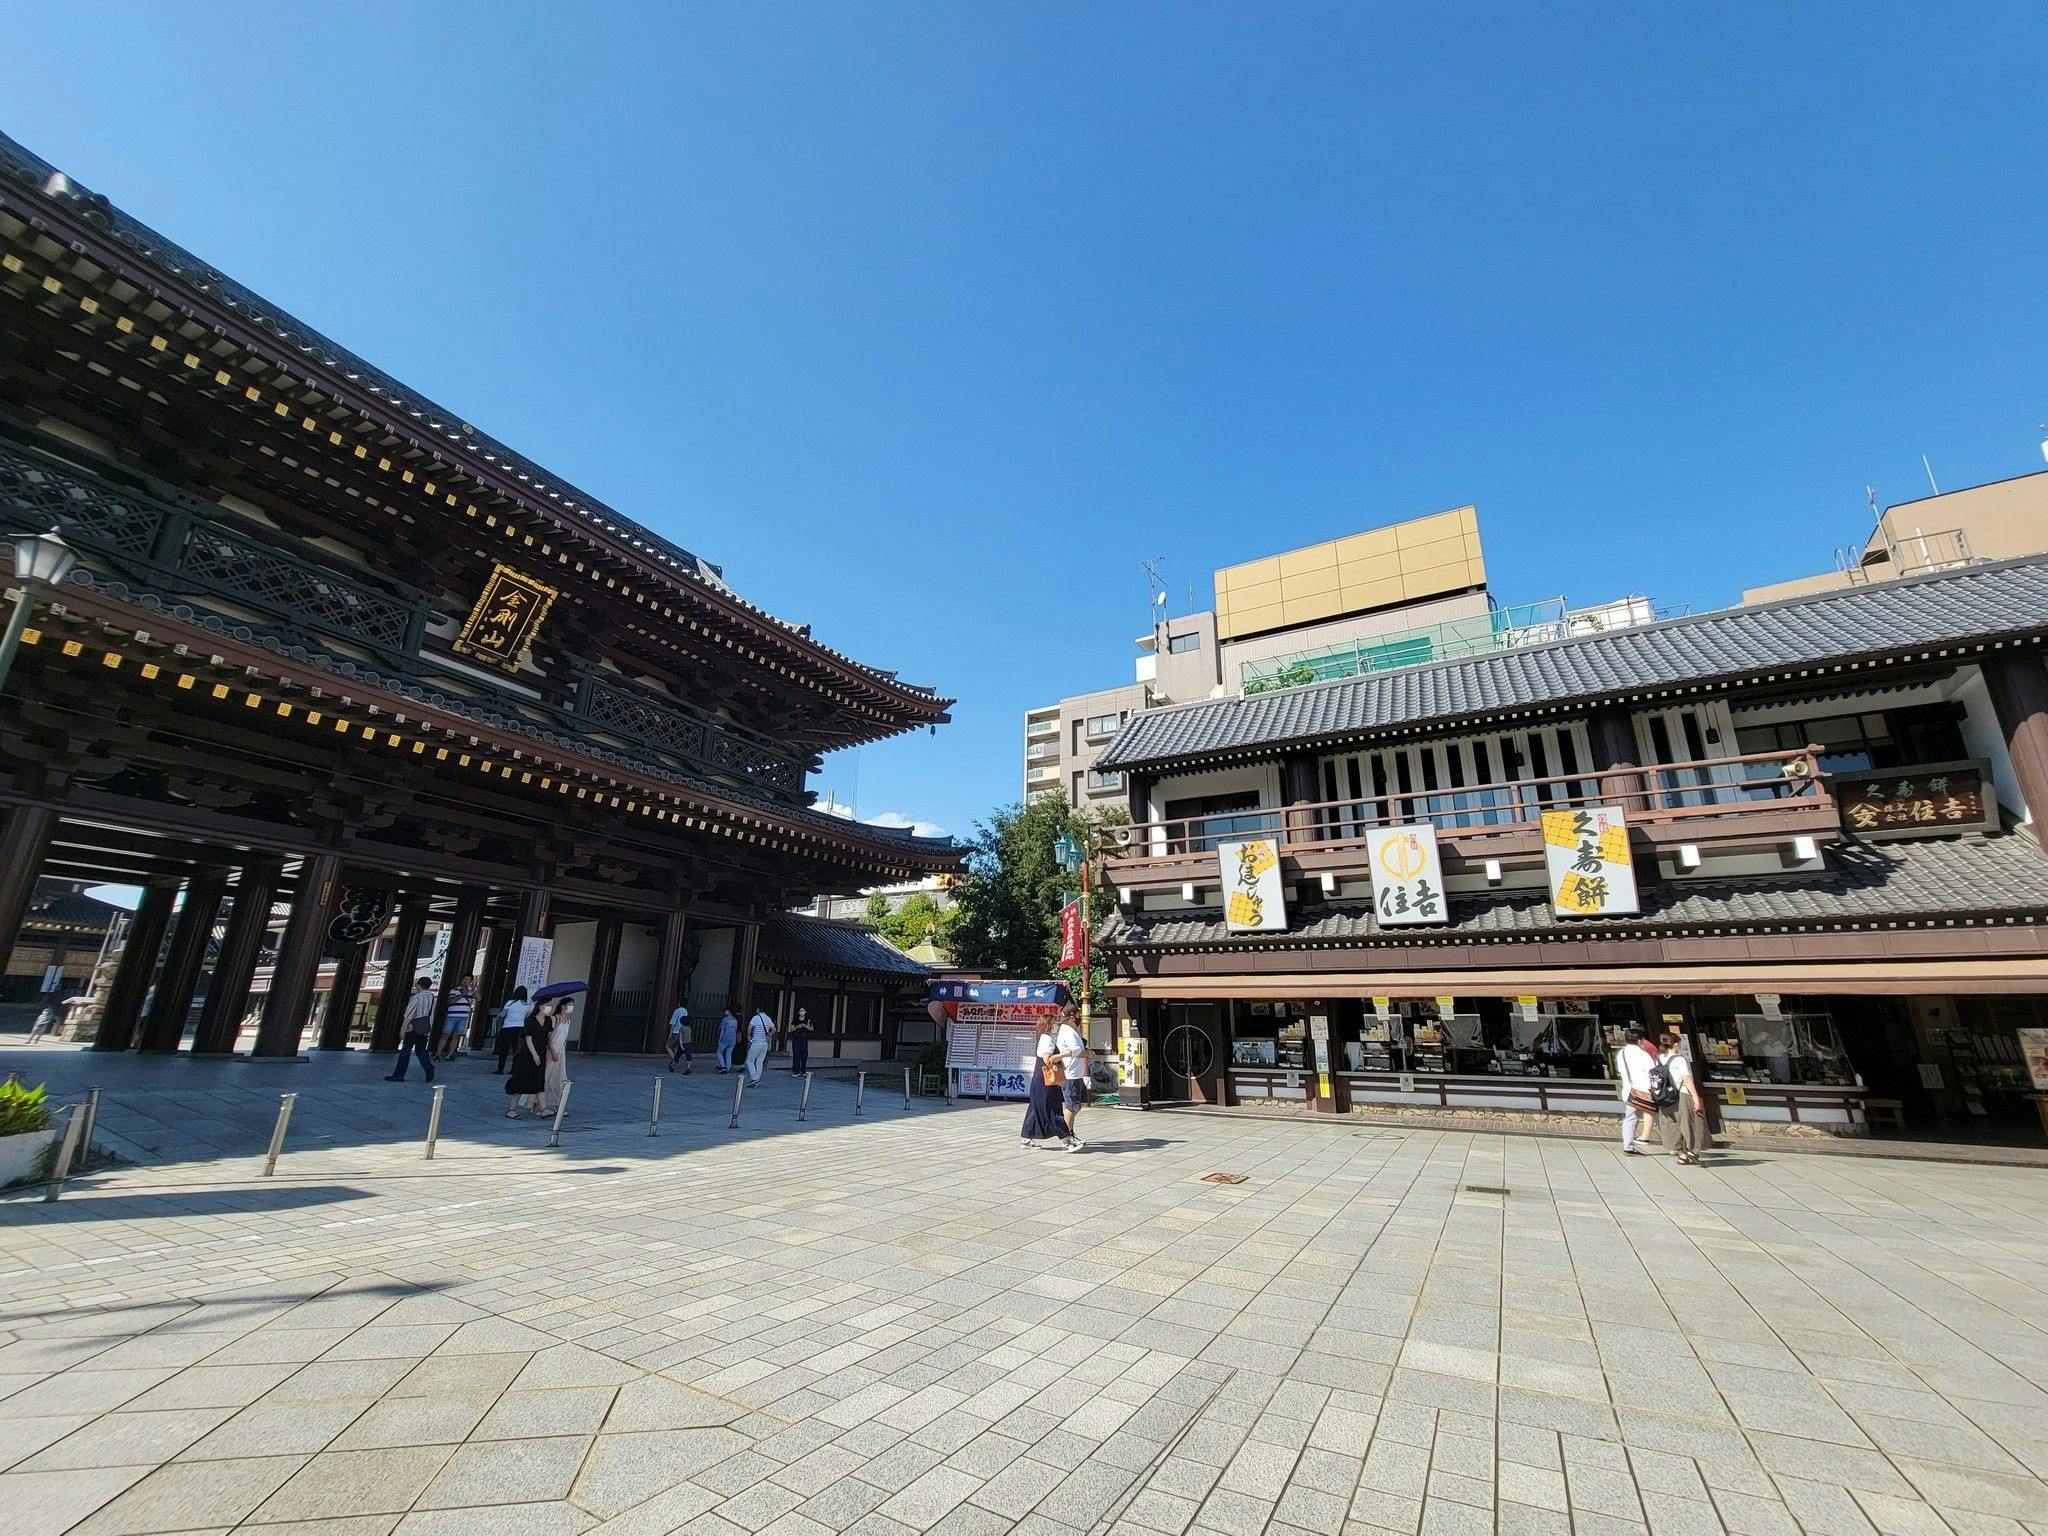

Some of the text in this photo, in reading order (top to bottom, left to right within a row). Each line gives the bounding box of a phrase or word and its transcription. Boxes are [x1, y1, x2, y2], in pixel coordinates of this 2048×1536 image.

[481, 590, 528, 648] 金剛山
[1910, 797, 1968, 821] 住吉
[1570, 810, 1610, 907] 久寿餅
[1380, 879, 1440, 917] 住吉
